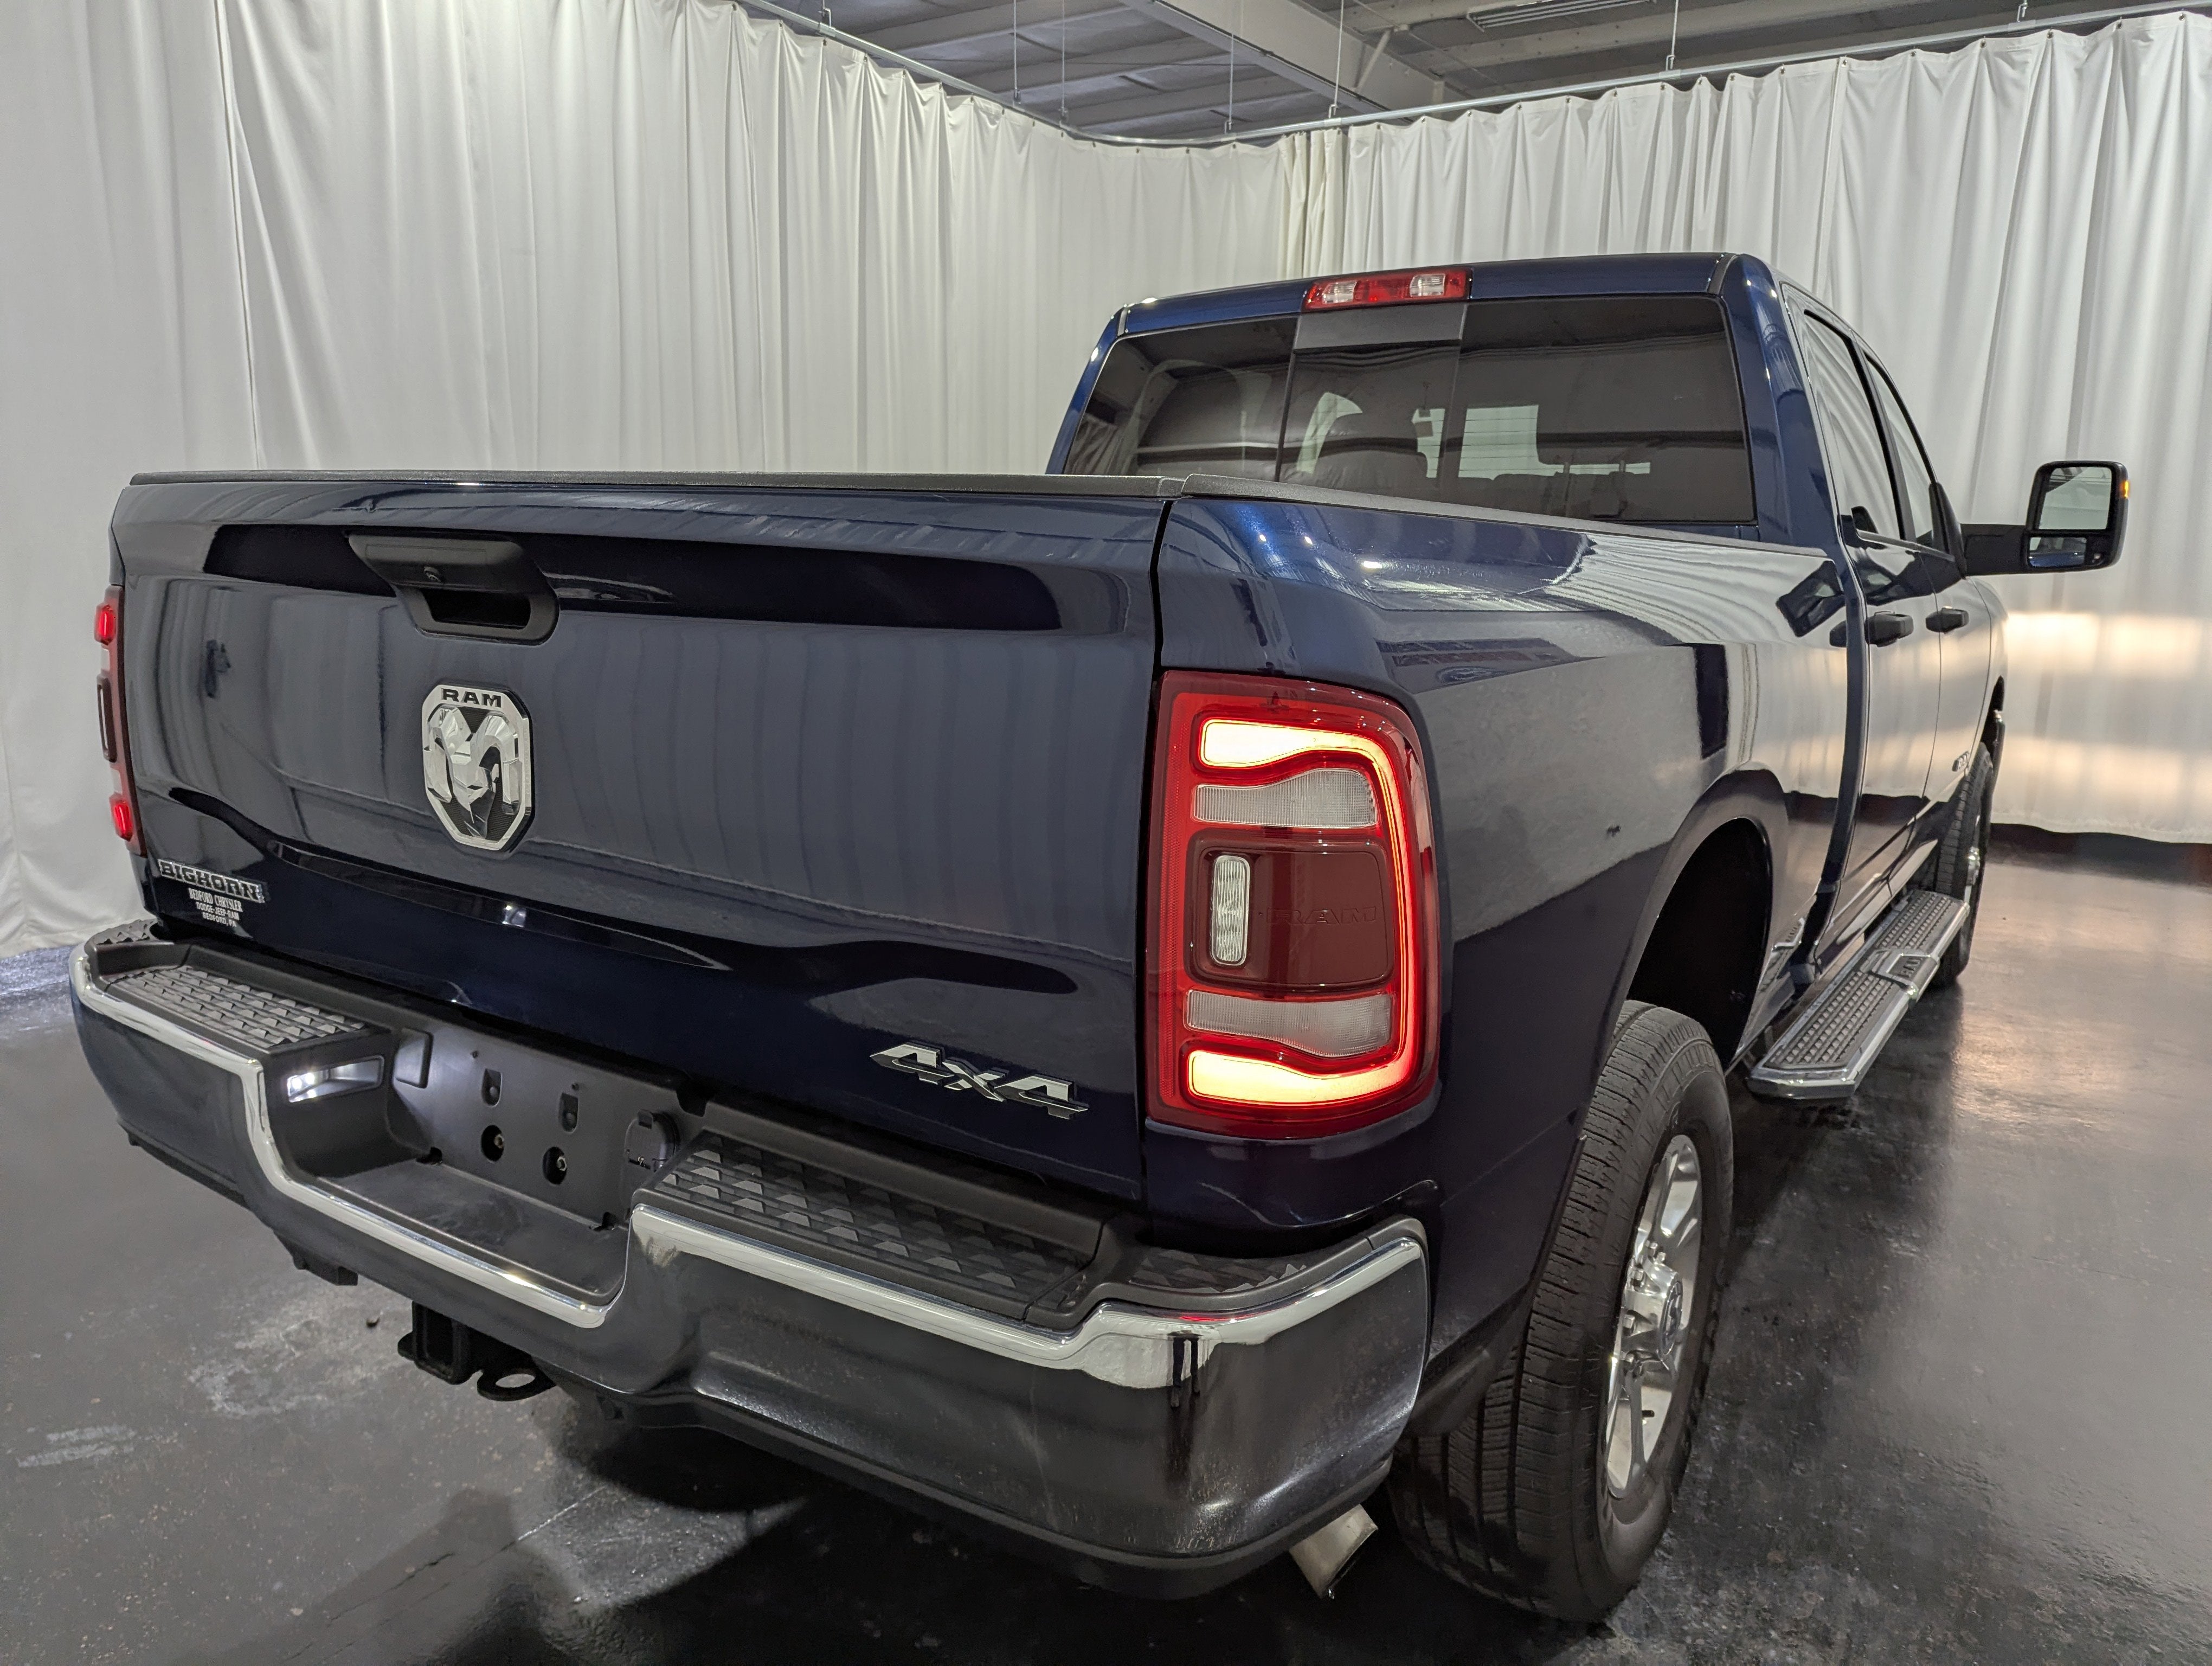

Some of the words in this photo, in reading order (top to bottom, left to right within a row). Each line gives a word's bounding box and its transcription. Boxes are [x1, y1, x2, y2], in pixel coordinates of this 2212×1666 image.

[441, 688, 502, 708] RAM
[158, 859, 265, 904] BIGHORN
[188, 887, 214, 905] BEDFORD
[214, 894, 243, 912] CHRYSLER
[1266, 906, 1377, 925] RAM
